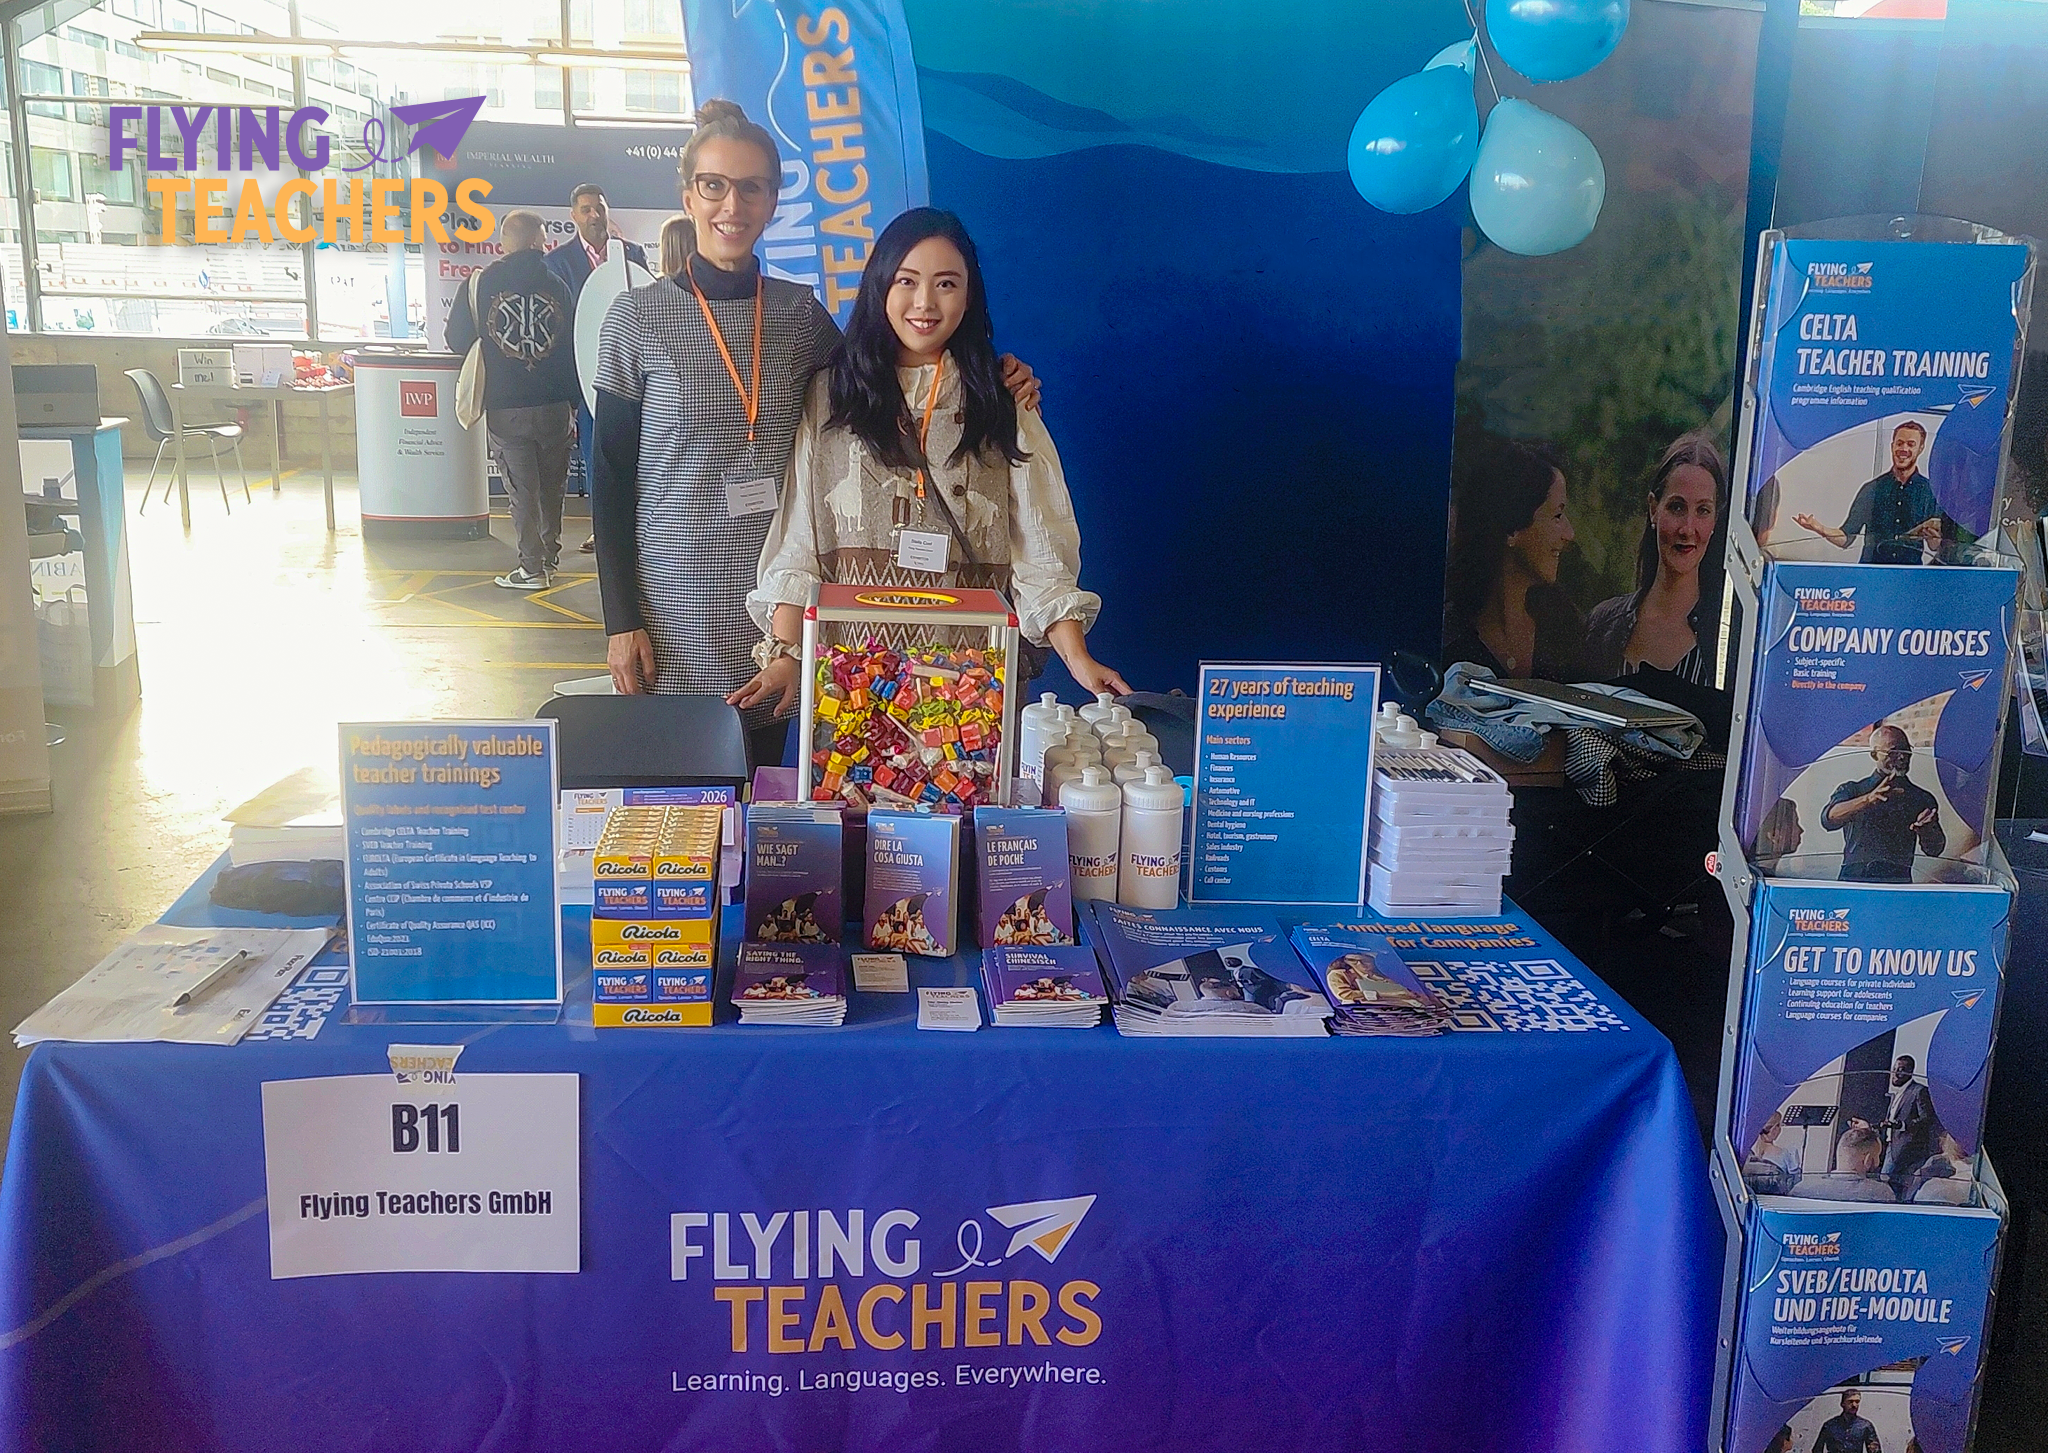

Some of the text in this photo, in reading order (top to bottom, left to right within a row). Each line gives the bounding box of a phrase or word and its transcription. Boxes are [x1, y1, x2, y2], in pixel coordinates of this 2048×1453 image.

[797, 7, 875, 315] TEACHERS
[763, 160, 819, 297] YING
[1808, 262, 1847, 275] FLYING
[1814, 275, 1872, 288] TEACHERS
[1800, 313, 1858, 341] CELTA
[193, 353, 214, 365] Win
[1797, 348, 1990, 378] TEACHER TRAINING
[1793, 383, 1922, 396] Cambridge English teaching qualification
[404, 392, 433, 406] IWP
[1791, 396, 1868, 406] programme information
[1794, 587, 1830, 599] FLYING
[1800, 600, 1856, 612] TEACHERS
[1789, 626, 1991, 656] COMPANY COURSES
[1794, 657, 1846, 667] Subject-specific
[1793, 669, 1837, 679] Basic training
[1209, 676, 1354, 700] 27 years of teaching
[1791, 681, 1815, 691] Directly
[1824, 682, 1835, 690] the
[1836, 684, 1866, 692] company
[1208, 700, 1286, 722] experience
[1206, 735, 1251, 745] Main sectors
[351, 734, 543, 760] Pedagogically valuable
[1210, 752, 1257, 761] Human Resources
[353, 762, 501, 788] teacher trainings
[701, 790, 727, 804] 2026
[1208, 797, 1238, 807] Technology
[1239, 798, 1249, 806] and
[756, 843, 798, 856] WIE SAGT
[874, 839, 903, 852] DIRE LA
[986, 839, 1038, 854] LE FRANÇAIS
[874, 853, 924, 867] COSA GIUSTA
[987, 855, 998, 867] DE
[1069, 854, 1101, 867] FLYING
[1130, 853, 1165, 866] FLYING
[597, 862, 648, 876] Ricola
[657, 862, 707, 876] Ricola
[1073, 864, 1116, 877] TEACHERS
[598, 887, 627, 897] FLYING
[657, 888, 686, 897] FLYING
[604, 896, 648, 905] TEACHERS
[662, 896, 707, 906] TEACHERS
[1789, 909, 1825, 920] FLYING
[1113, 917, 1142, 929] FAITES
[1144, 925, 1212, 934] CONNAISSANCE
[1421, 922, 1520, 935] language
[1795, 920, 1850, 932] TEACHERS
[622, 926, 680, 940] Ricola
[1387, 935, 1417, 948] for
[1420, 936, 1536, 949] Companies
[597, 951, 648, 964] Ricola
[657, 951, 707, 964] Ricola
[1784, 946, 1977, 977] GET TO KNOW US
[598, 976, 627, 986] FLYING
[658, 976, 687, 987] FLYING
[1789, 976, 1916, 989] Language courses for private individuals
[603, 985, 647, 995] TEACHERS
[663, 986, 707, 996] TEACHERS
[1788, 988, 1892, 999] Learning support for adolescents
[1787, 999, 1893, 1010] Continuing education for teachers
[623, 1009, 682, 1023] Ricola
[1785, 1011, 1815, 1020] Language
[1843, 1011, 1853, 1020] for
[1854, 1013, 1888, 1022] companies
[390, 1056, 453, 1070] EACHERS
[424, 1071, 456, 1084] YING
[392, 1103, 460, 1152] B11
[301, 1190, 552, 1219] Flying Teachers GmbH
[670, 1209, 920, 1280] FLYING
[1783, 1233, 1819, 1245] FLYING
[1789, 1244, 1840, 1255] TEACHERS
[1776, 1267, 1928, 1294] SVEB/EUROLTA
[714, 1280, 1103, 1353] TEACHERS
[1774, 1297, 1953, 1323] UND FIDE-MODULE
[1771, 1324, 1857, 1336] Weiterbildungsangebote für
[1770, 1335, 1883, 1345] Kursleitende und Sprachkursleitende
[671, 1361, 1107, 1396] Learning. Languages. Everywhere.
